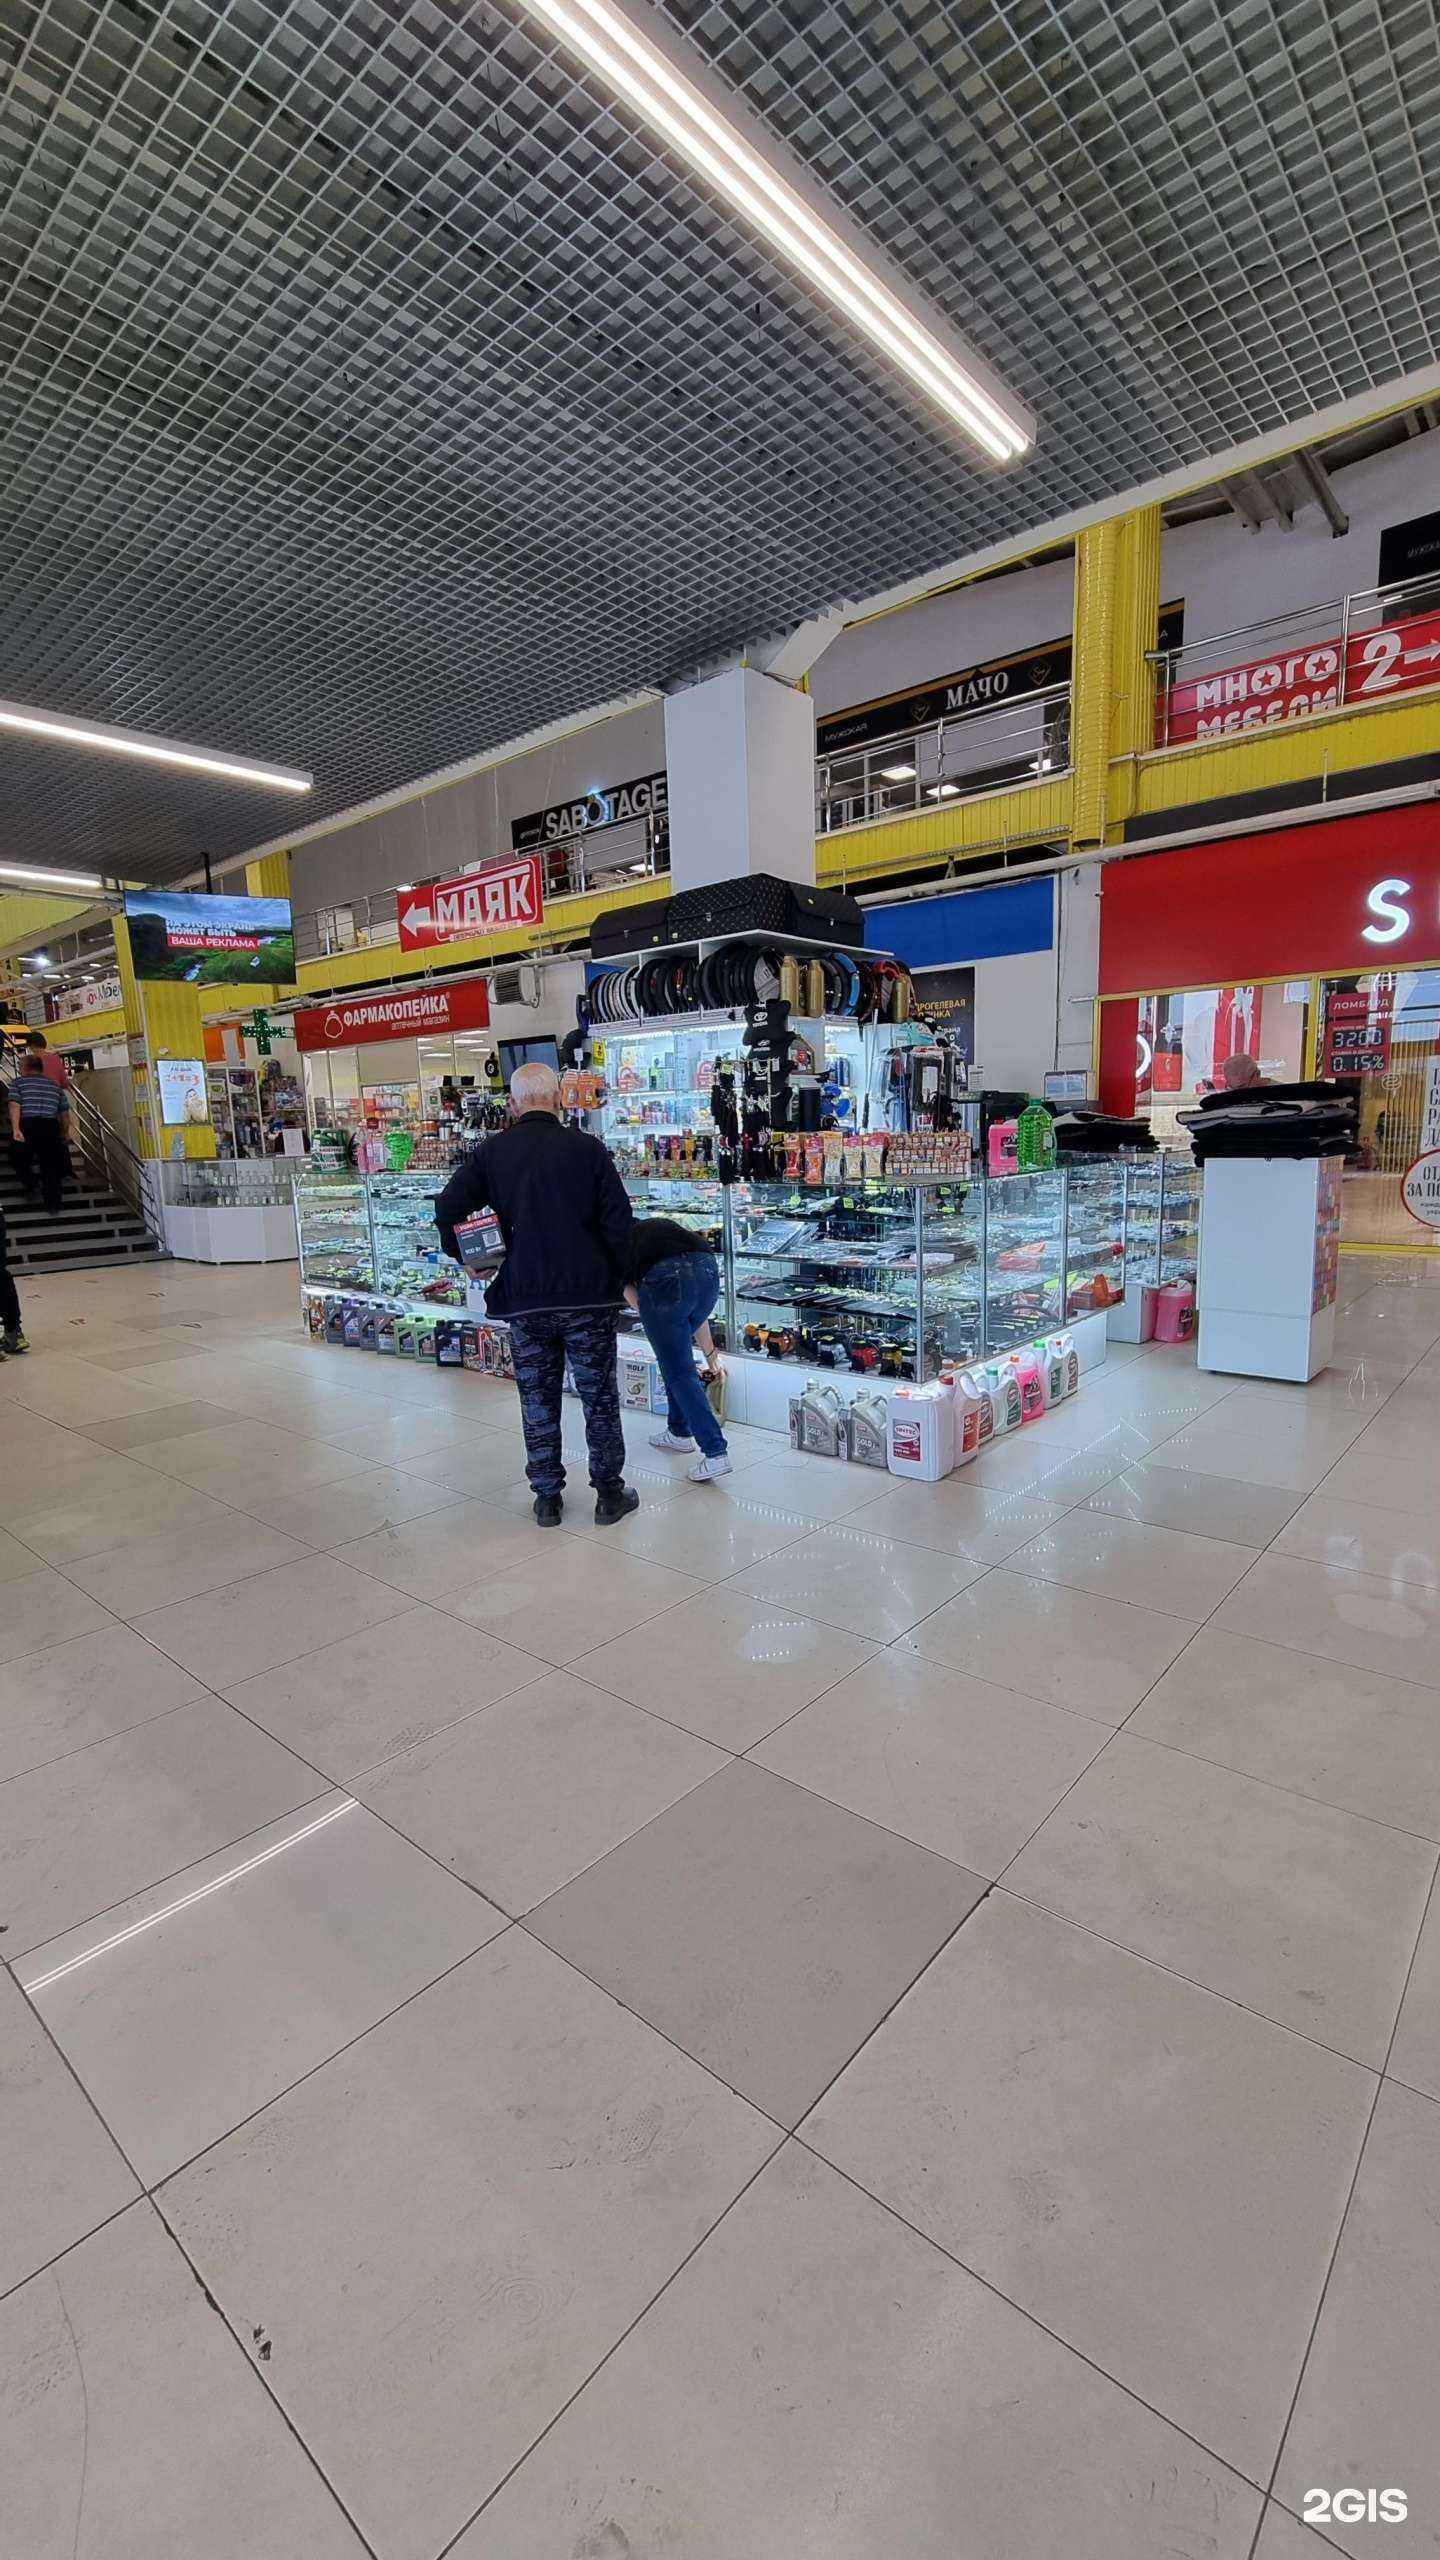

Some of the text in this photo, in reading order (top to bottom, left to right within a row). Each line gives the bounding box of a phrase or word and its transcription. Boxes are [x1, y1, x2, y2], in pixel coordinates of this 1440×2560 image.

[945, 671, 1010, 710] МАЧО
[1196, 649, 1338, 712] МНОГО
[1360, 633, 1402, 693] 2
[546, 777, 666, 839] SABOTAGE
[437, 874, 532, 933] МАЯК
[171, 936, 255, 948] ВАША РЕКЛАМА
[1407, 1183, 1422, 1198] ЗА
